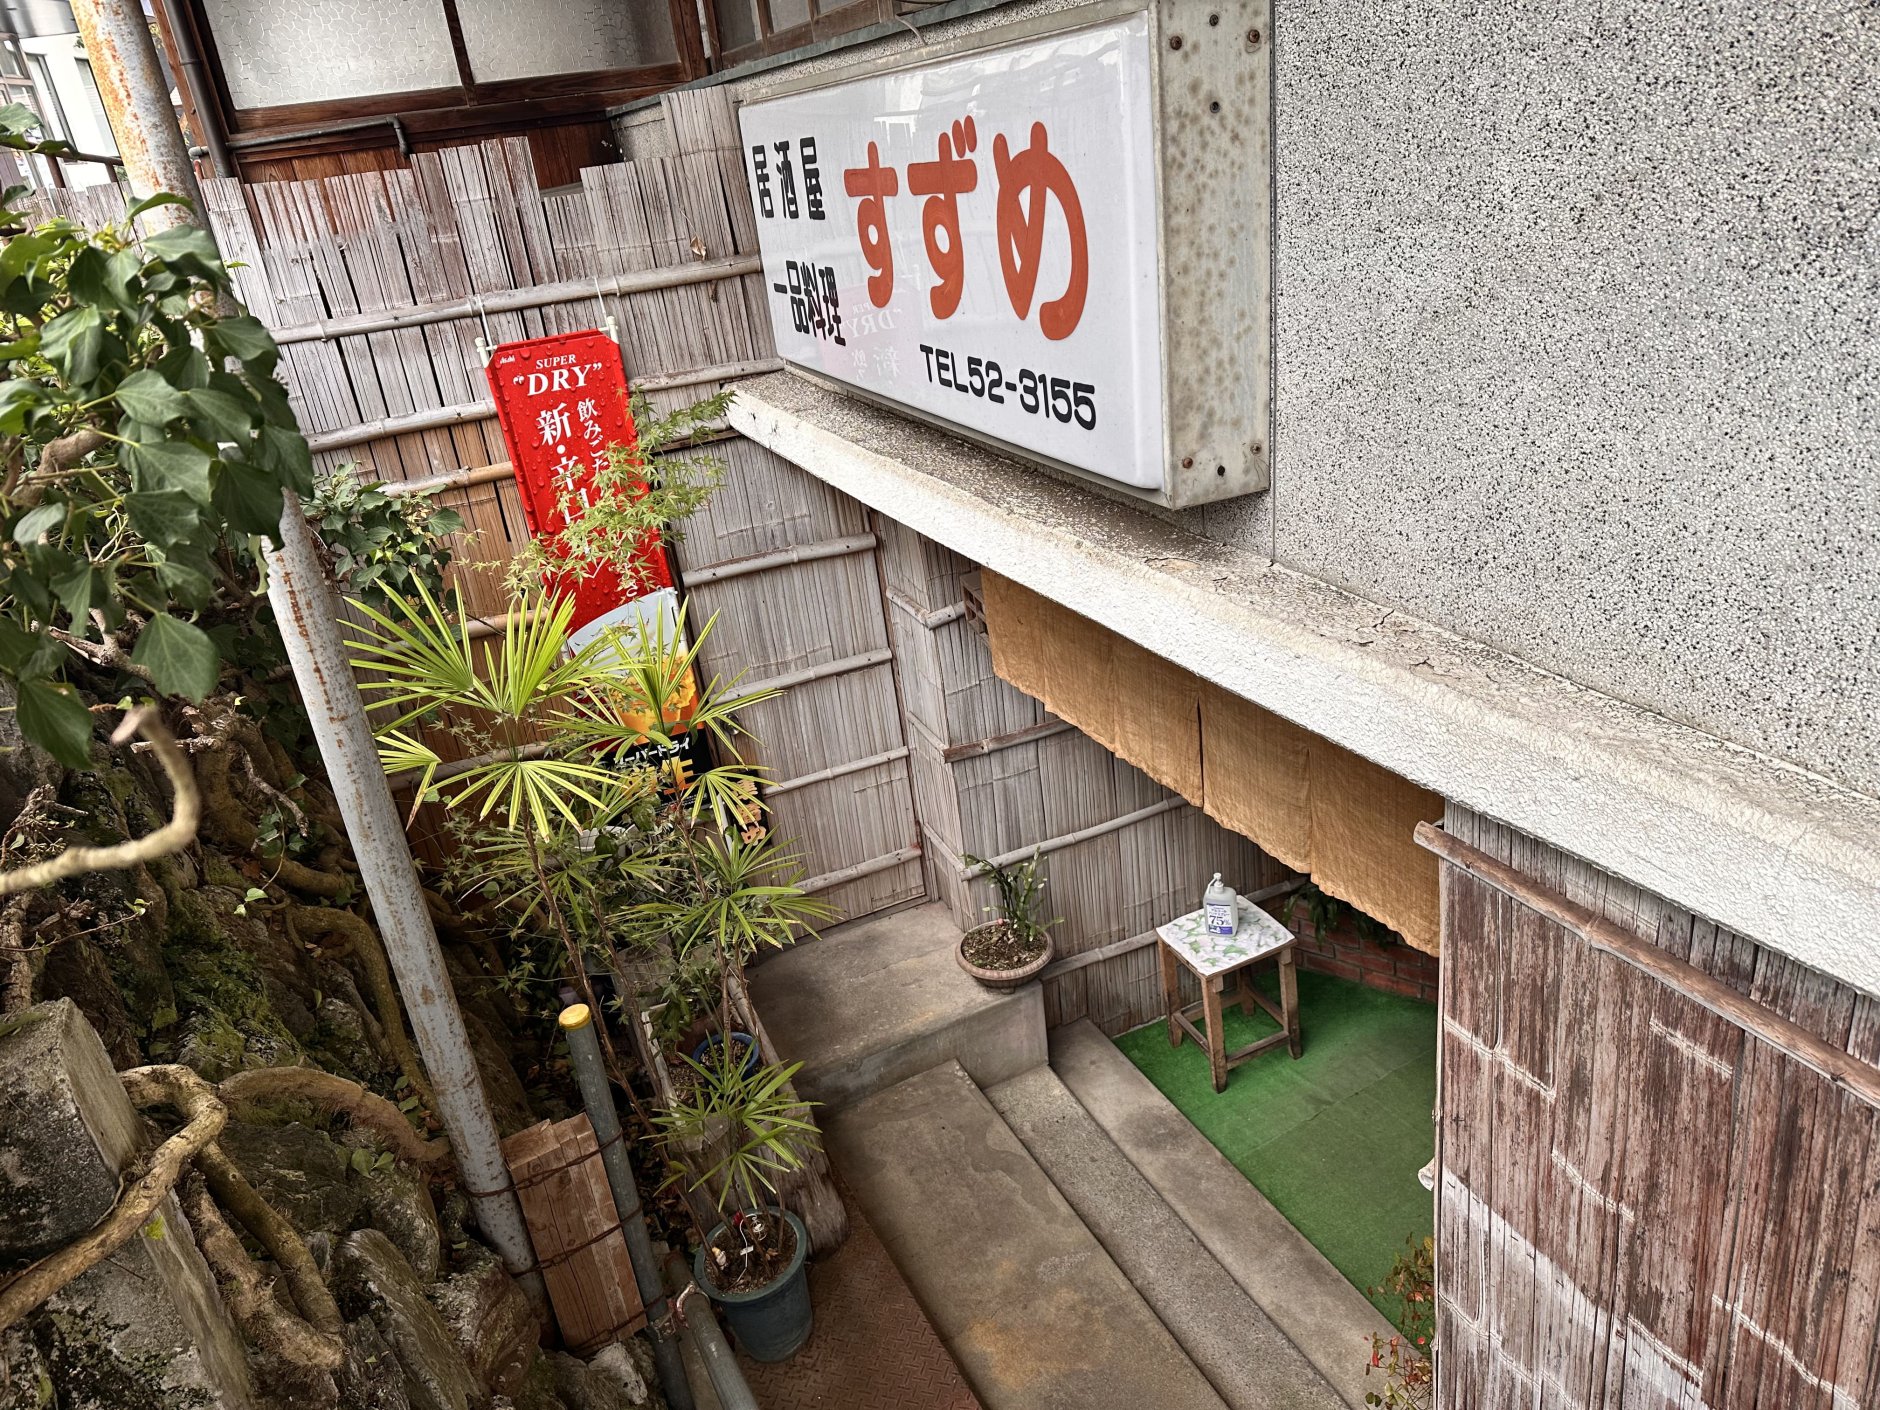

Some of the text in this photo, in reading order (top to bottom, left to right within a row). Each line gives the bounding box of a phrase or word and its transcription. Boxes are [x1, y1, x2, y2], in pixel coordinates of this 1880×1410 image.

[752, 136, 825, 220] 居酒屋
[844, 115, 1089, 341] すずめ
[773, 259, 846, 346] 一品料理
[536, 354, 577, 369] SUPER
[536, 402, 593, 555] 新・辛口
